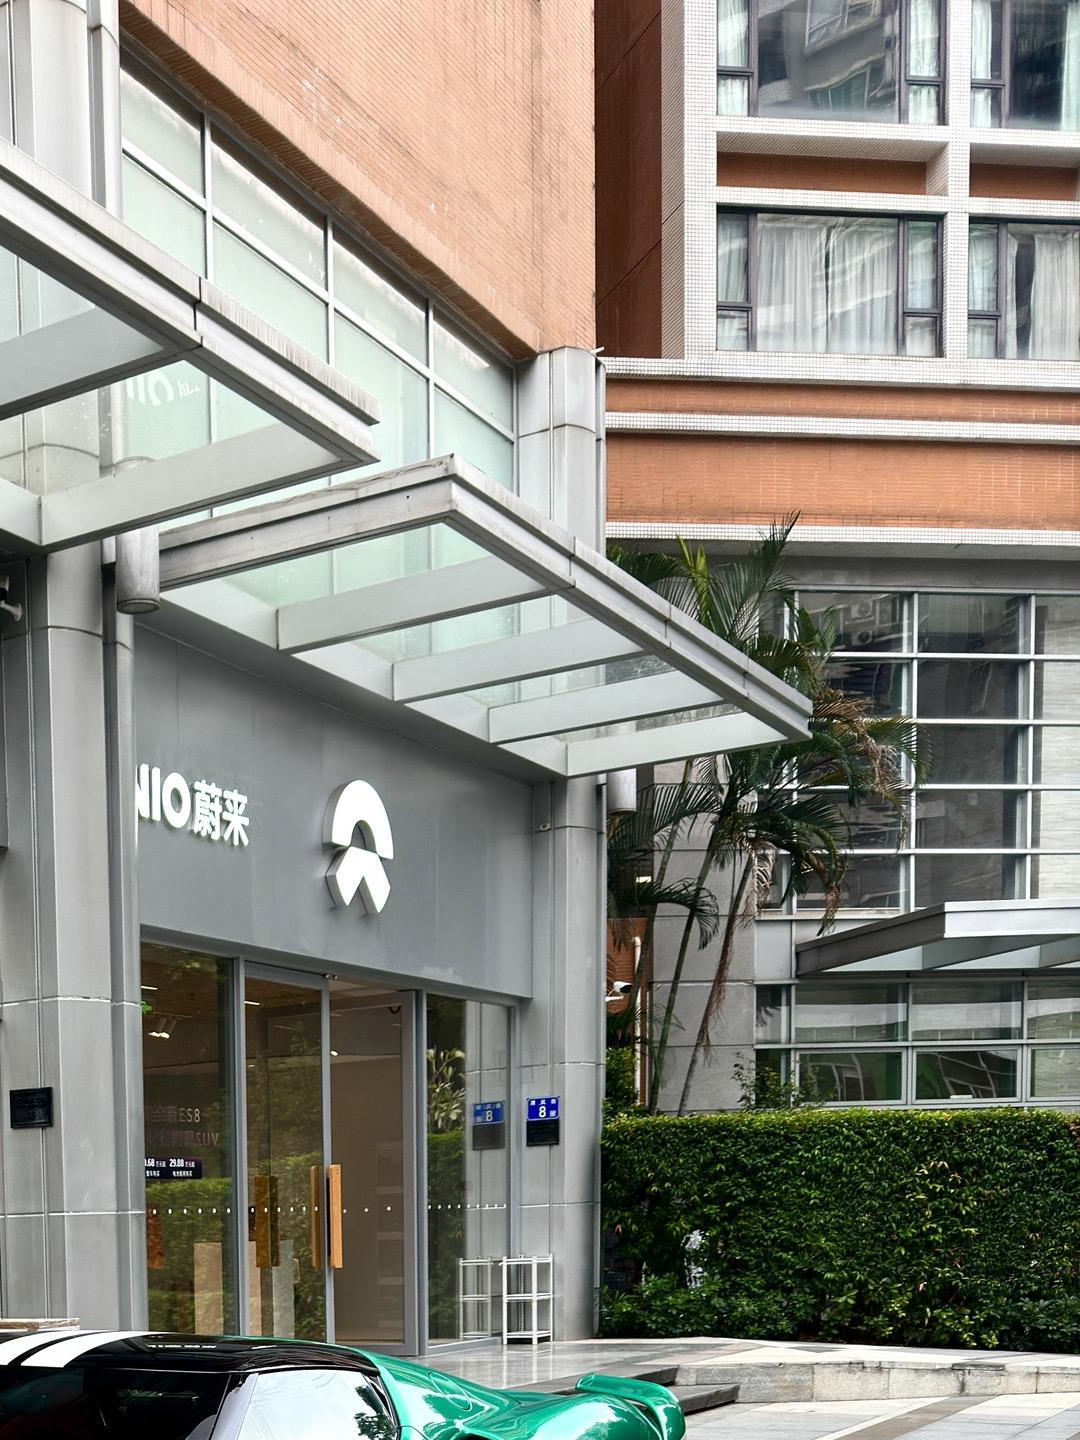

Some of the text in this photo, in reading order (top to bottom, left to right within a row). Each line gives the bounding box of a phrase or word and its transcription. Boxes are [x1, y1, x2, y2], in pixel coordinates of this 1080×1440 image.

[135, 763, 250, 847] NIO 蔚来
[538, 1105, 547, 1118] 8
